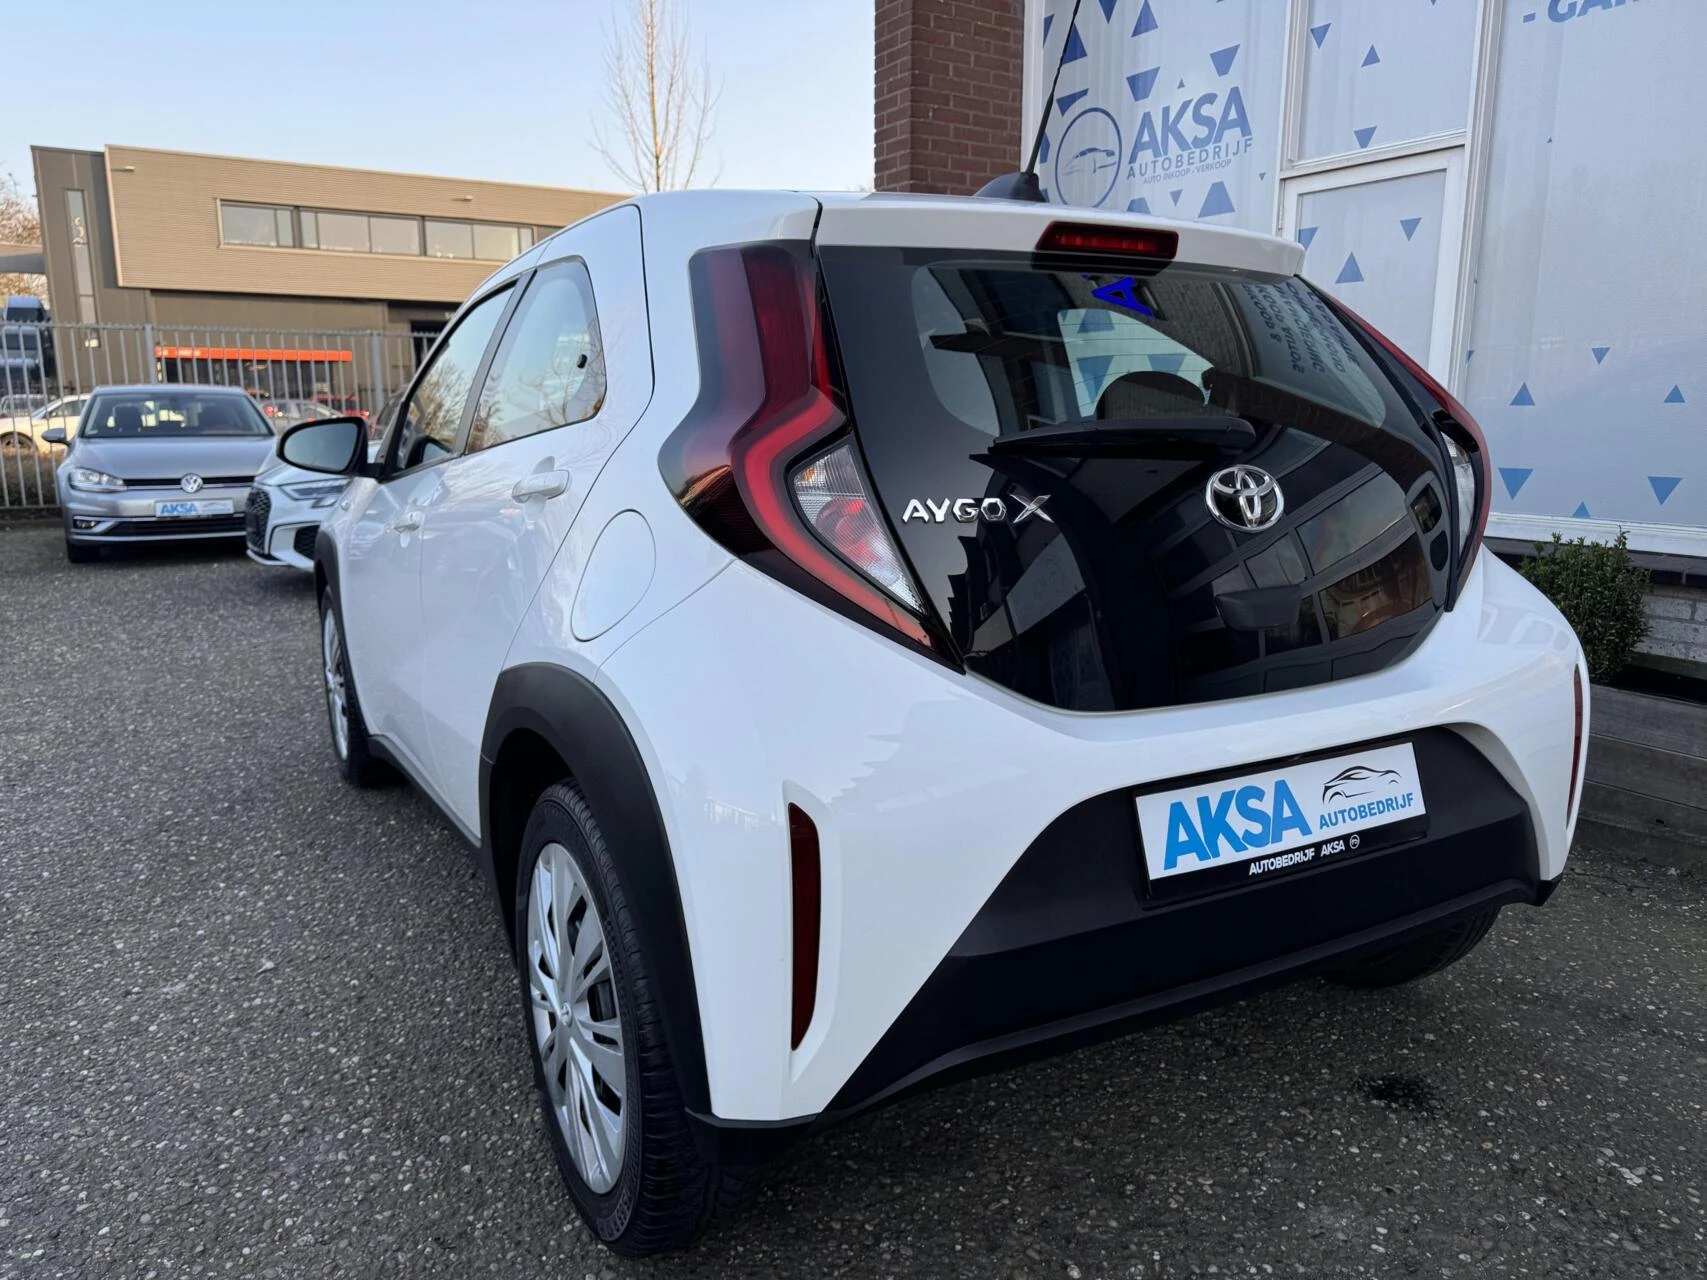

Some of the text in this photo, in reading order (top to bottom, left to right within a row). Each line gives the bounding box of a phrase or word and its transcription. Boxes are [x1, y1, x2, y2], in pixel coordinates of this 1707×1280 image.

[1128, 86, 1252, 165] AKSA
[1127, 137, 1252, 180] AUTOBEDRIJF
[1143, 173, 1162, 184] AUTO
[1163, 166, 1190, 181] INKOOP
[1196, 158, 1232, 174] VERKOOP
[161, 503, 199, 514] AKSA
[902, 494, 1055, 524] AYGO X
[1164, 779, 1312, 870] AKSA
[1319, 792, 1414, 830] AUTOBEDRIJF
[1249, 839, 1345, 876] AUTOBEDRIJF AKSA
